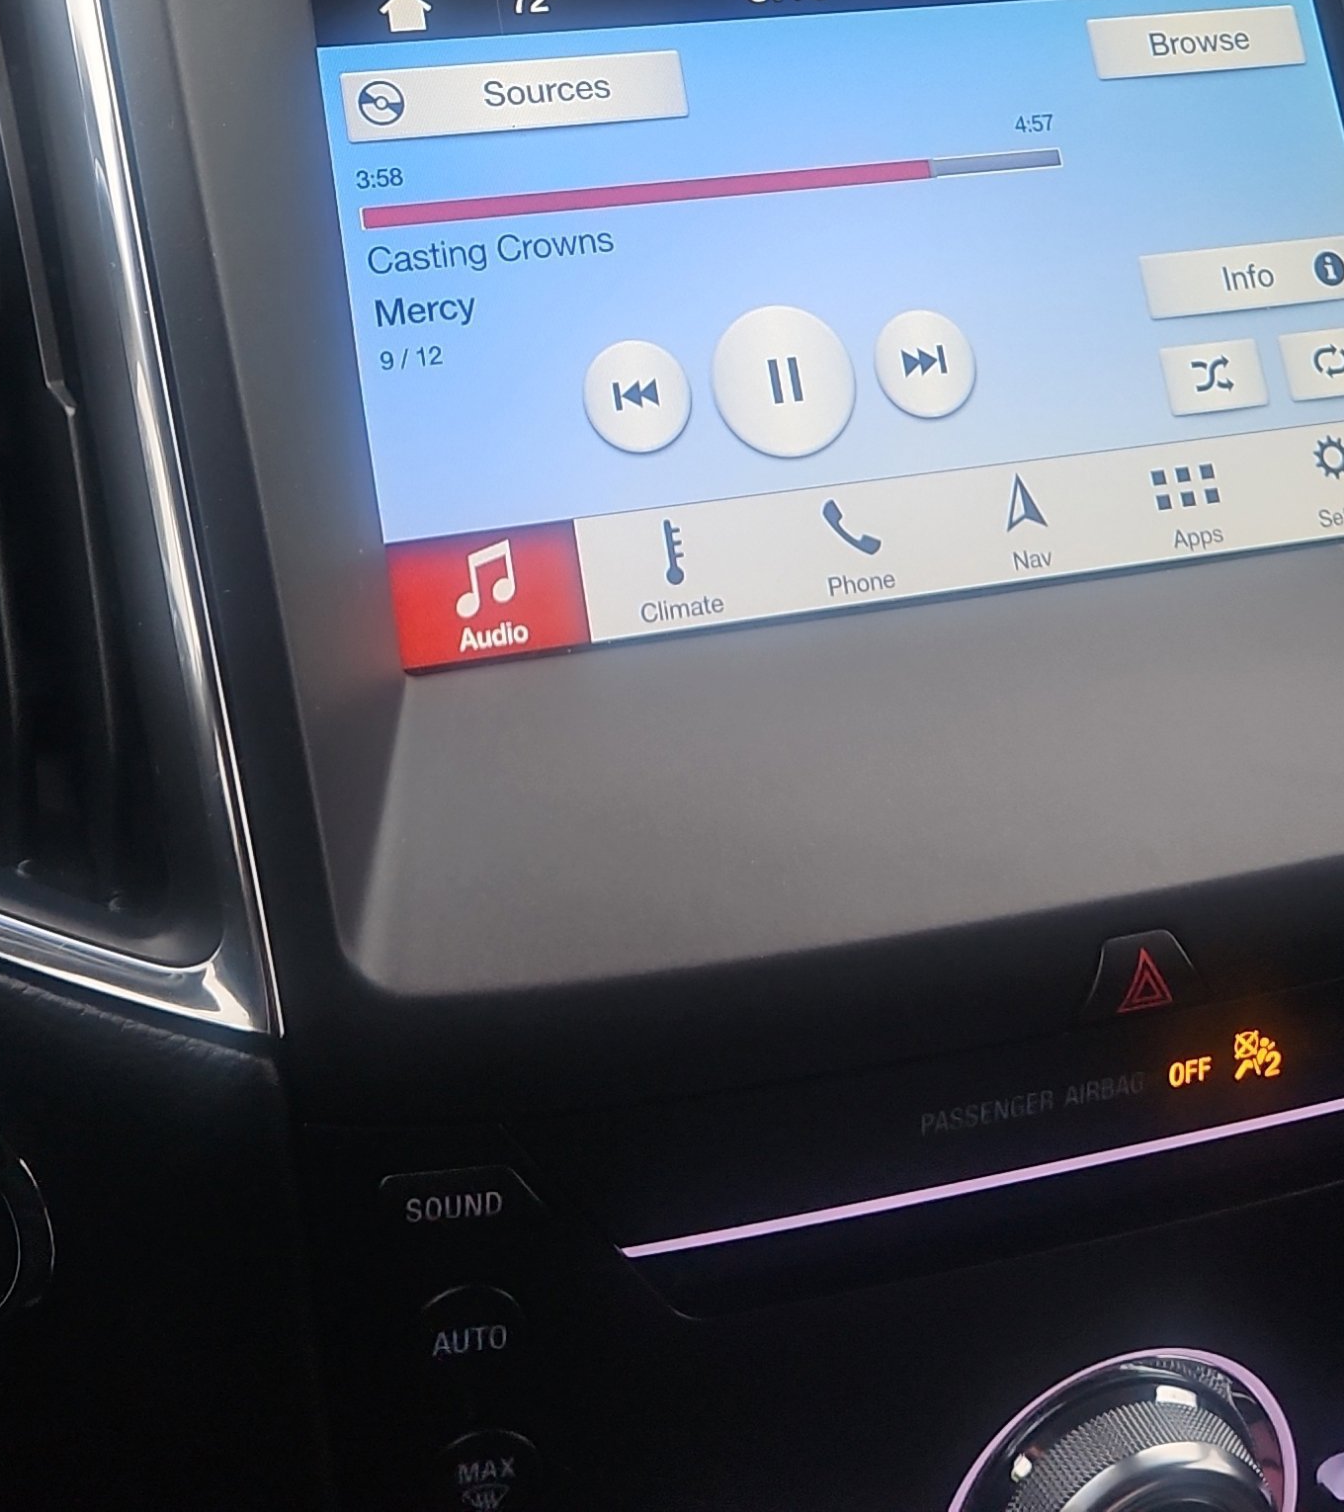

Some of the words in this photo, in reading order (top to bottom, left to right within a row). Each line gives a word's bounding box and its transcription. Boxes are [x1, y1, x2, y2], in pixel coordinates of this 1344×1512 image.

[1147, 28, 1251, 58] Browse
[482, 76, 612, 109] Sources
[1014, 113, 1055, 135] 4:57
[355, 167, 405, 190] 3:58
[367, 240, 489, 275] Casting
[496, 229, 616, 264] Crowns
[1221, 264, 1275, 293] Info
[374, 295, 477, 329] Mercy
[379, 350, 394, 371] 9
[415, 346, 444, 368] 12
[1173, 525, 1225, 551] Apps
[1012, 550, 1053, 572] Nav
[826, 571, 896, 597] Phone
[639, 595, 725, 625] Climate
[459, 620, 530, 653] Audio
[920, 1090, 1055, 1137] PASSENGER
[1063, 1071, 1147, 1108] AIRBAG
[1168, 1055, 1213, 1088] OFF
[405, 1191, 504, 1223] SOUND
[431, 1324, 508, 1357] AUTO
[457, 1457, 516, 1483] MAX
